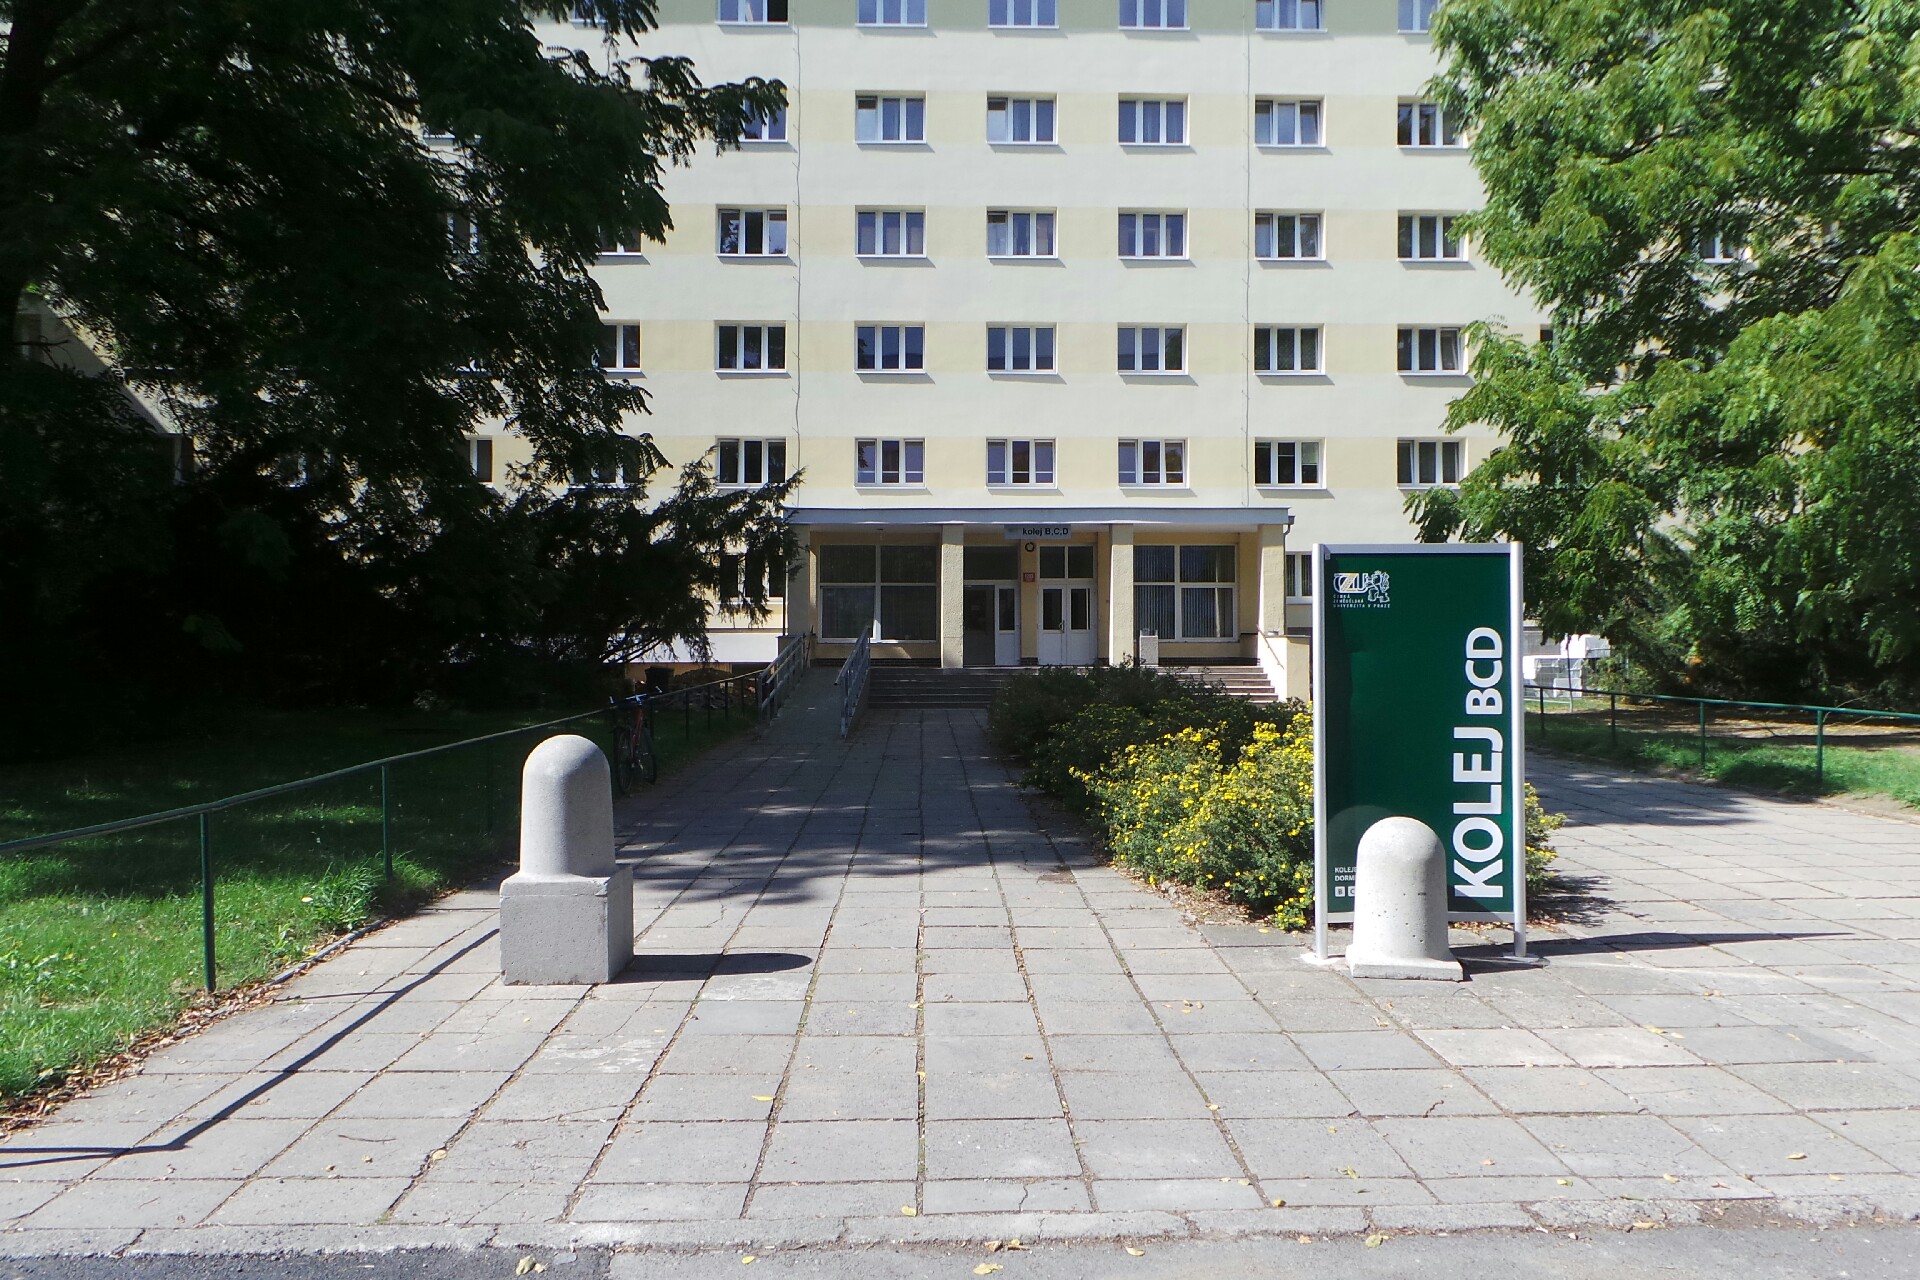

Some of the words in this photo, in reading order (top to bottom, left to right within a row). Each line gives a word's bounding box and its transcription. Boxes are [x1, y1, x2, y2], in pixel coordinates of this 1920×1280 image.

[1022, 527, 1043, 537] kolej
[1045, 527, 1069, 536] B,C,D
[1465, 626, 1503, 715] BCD
[1452, 726, 1504, 898] KOLEJ
